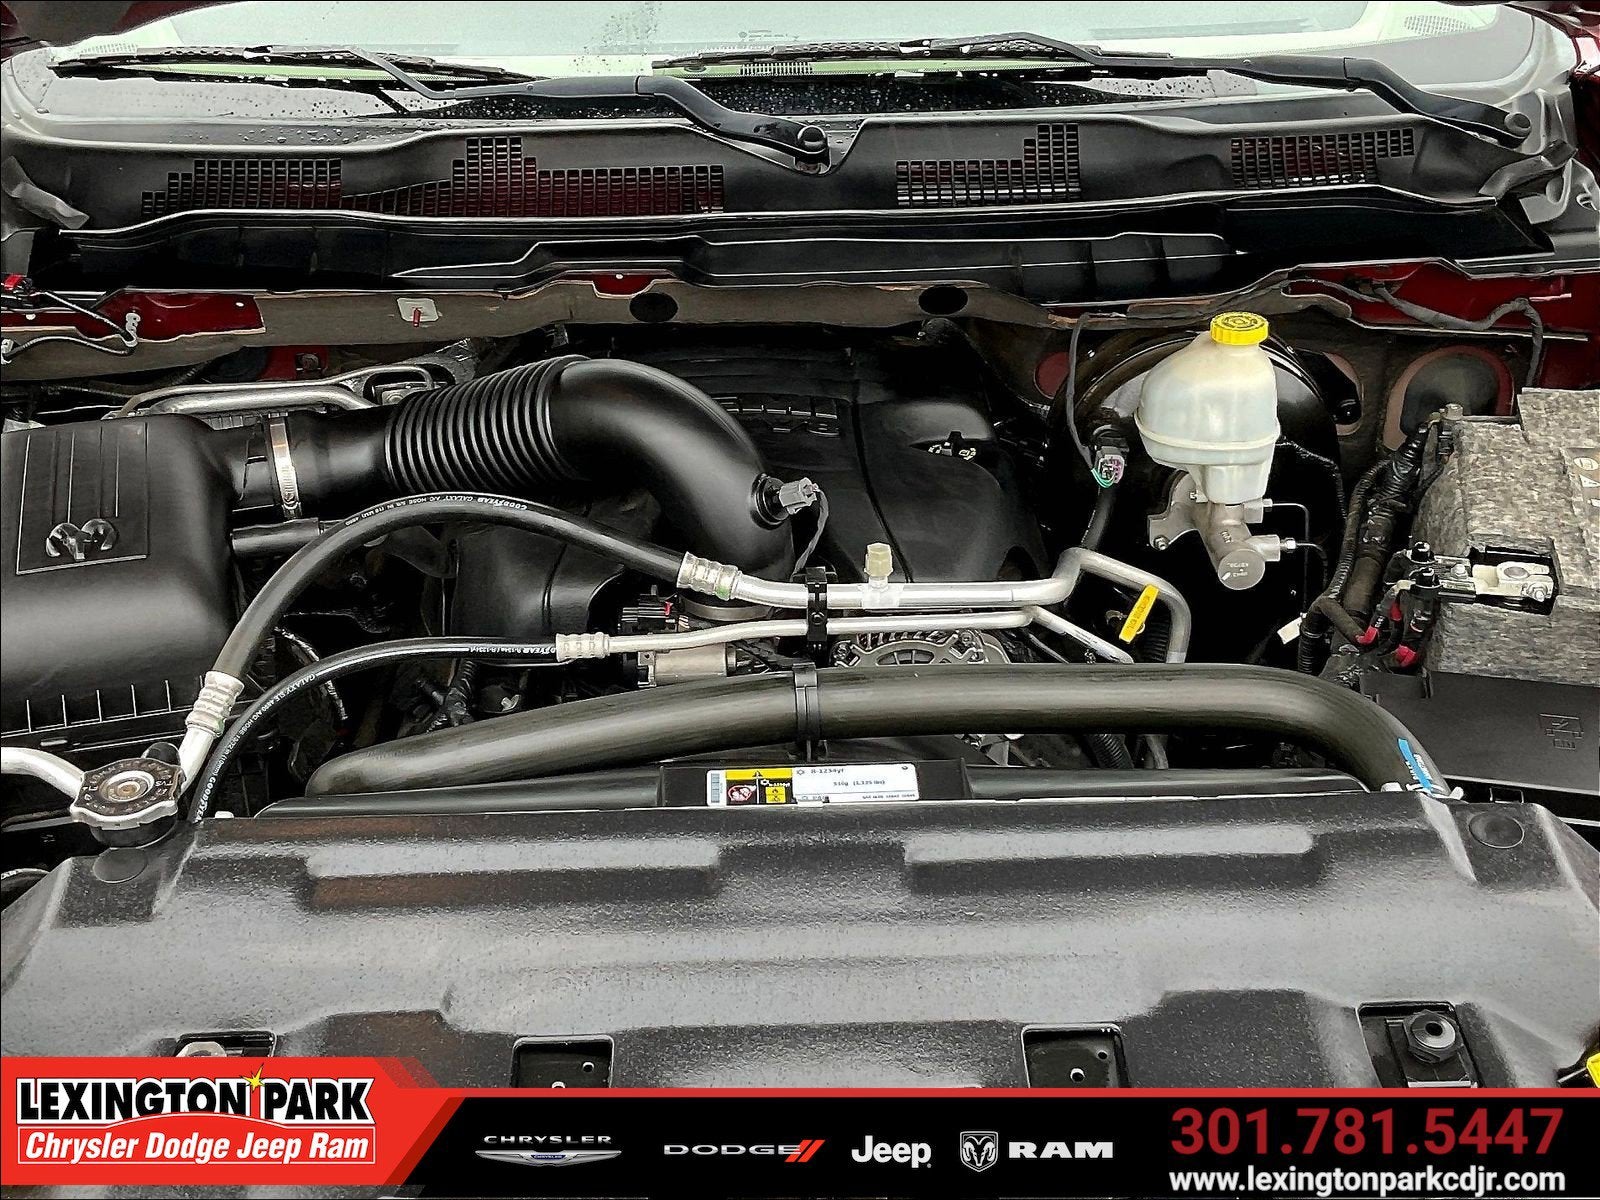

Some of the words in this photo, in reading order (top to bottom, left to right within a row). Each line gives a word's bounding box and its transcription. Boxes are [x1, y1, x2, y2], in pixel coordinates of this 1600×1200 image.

[408, 497, 427, 505] HOSE
[477, 497, 528, 510] GOODYEAR
[286, 673, 316, 695] GALAXY
[238, 718, 254, 736] HOSE
